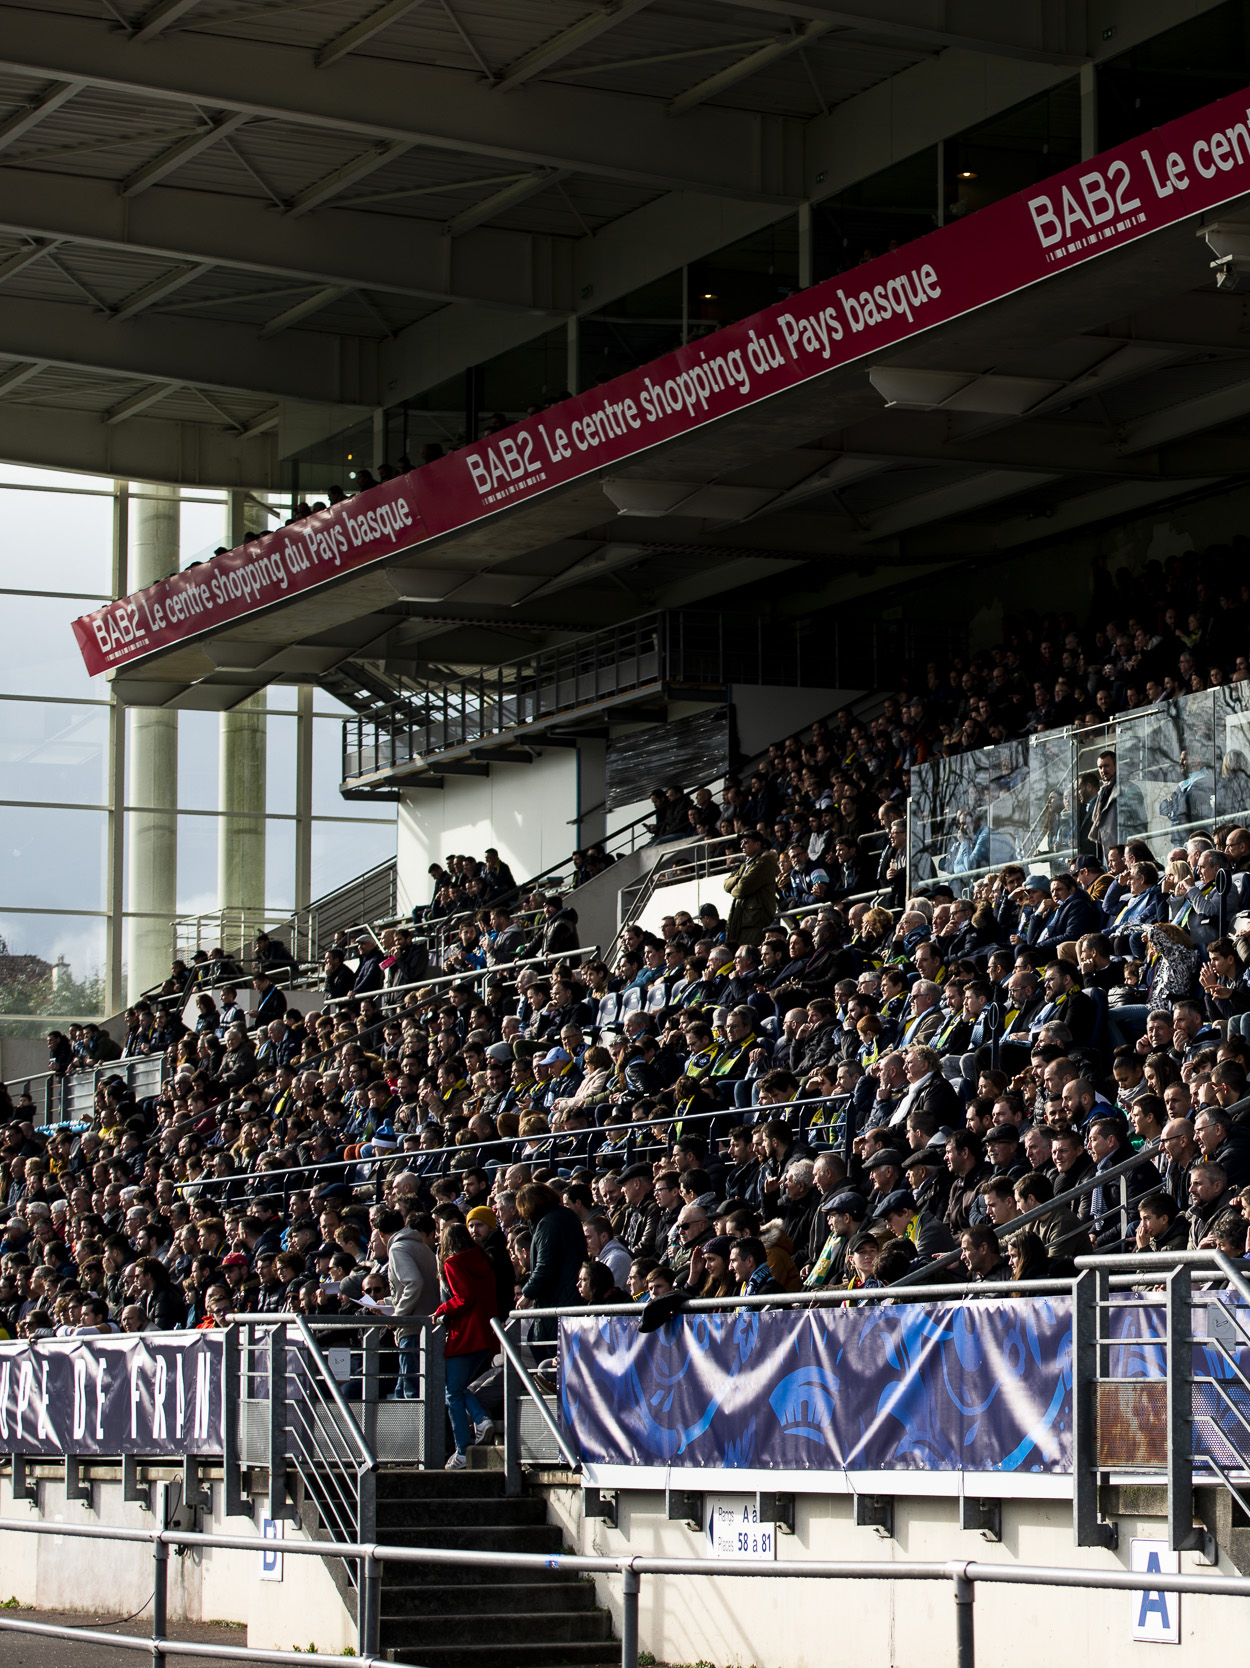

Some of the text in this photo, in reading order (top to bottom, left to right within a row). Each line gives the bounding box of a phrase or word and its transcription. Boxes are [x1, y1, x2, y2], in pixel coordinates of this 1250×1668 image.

[1028, 160, 1141, 248] BAB2
[1140, 148, 1190, 199] Le
[466, 263, 942, 495] BAB2 Le centre shopping du Pays basque
[92, 497, 413, 653] BAB2 Le centre shopping du Pays basque
[73, 1358, 107, 1440] DE
[131, 1351, 243, 1440] FRAN
[738, 1532, 749, 1552] 58
[752, 1533, 758, 1553] à
[761, 1533, 771, 1553] 81
[743, 1505, 749, 1523] A
[752, 1504, 758, 1524] à
[1138, 1552, 1171, 1629] A
